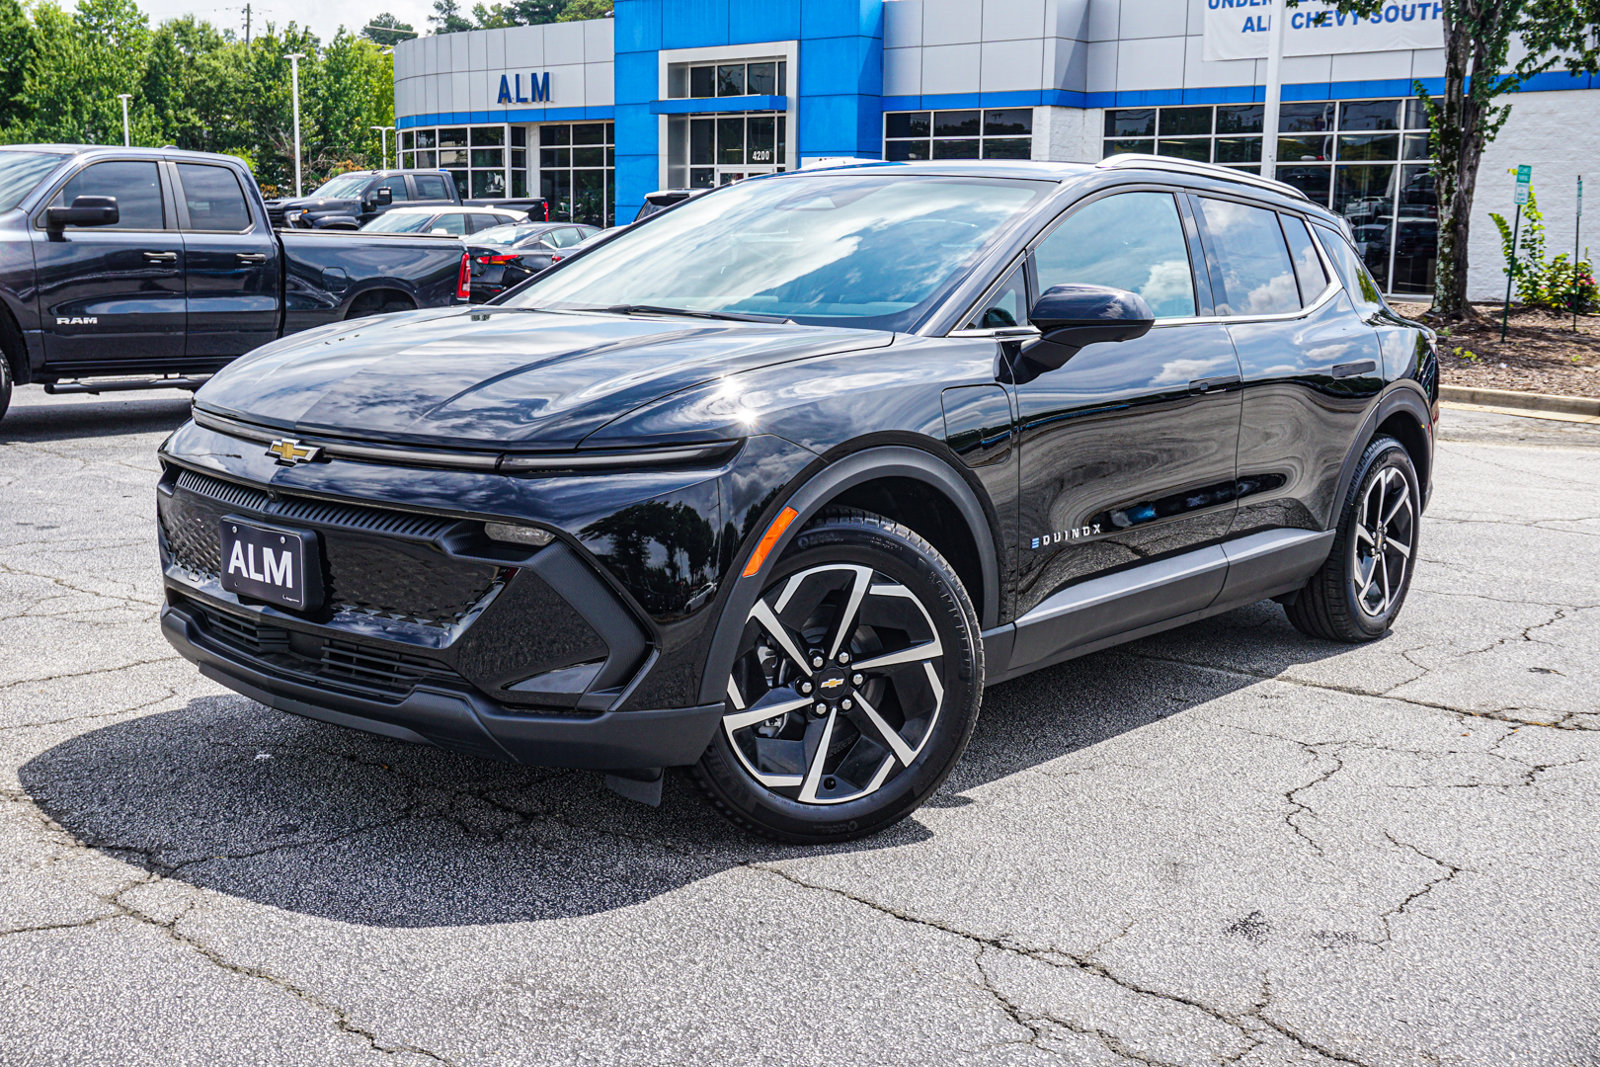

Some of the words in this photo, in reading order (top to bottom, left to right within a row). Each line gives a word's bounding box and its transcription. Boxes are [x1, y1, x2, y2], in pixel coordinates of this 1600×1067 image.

[1241, 14, 1271, 33] AL
[1291, 9, 1360, 30] CHEVY
[497, 71, 550, 104] ALM
[752, 150, 770, 161] 4200
[56, 316, 98, 325] RAM
[1031, 523, 1101, 549] EQUINOX
[228, 539, 293, 589] ALM
